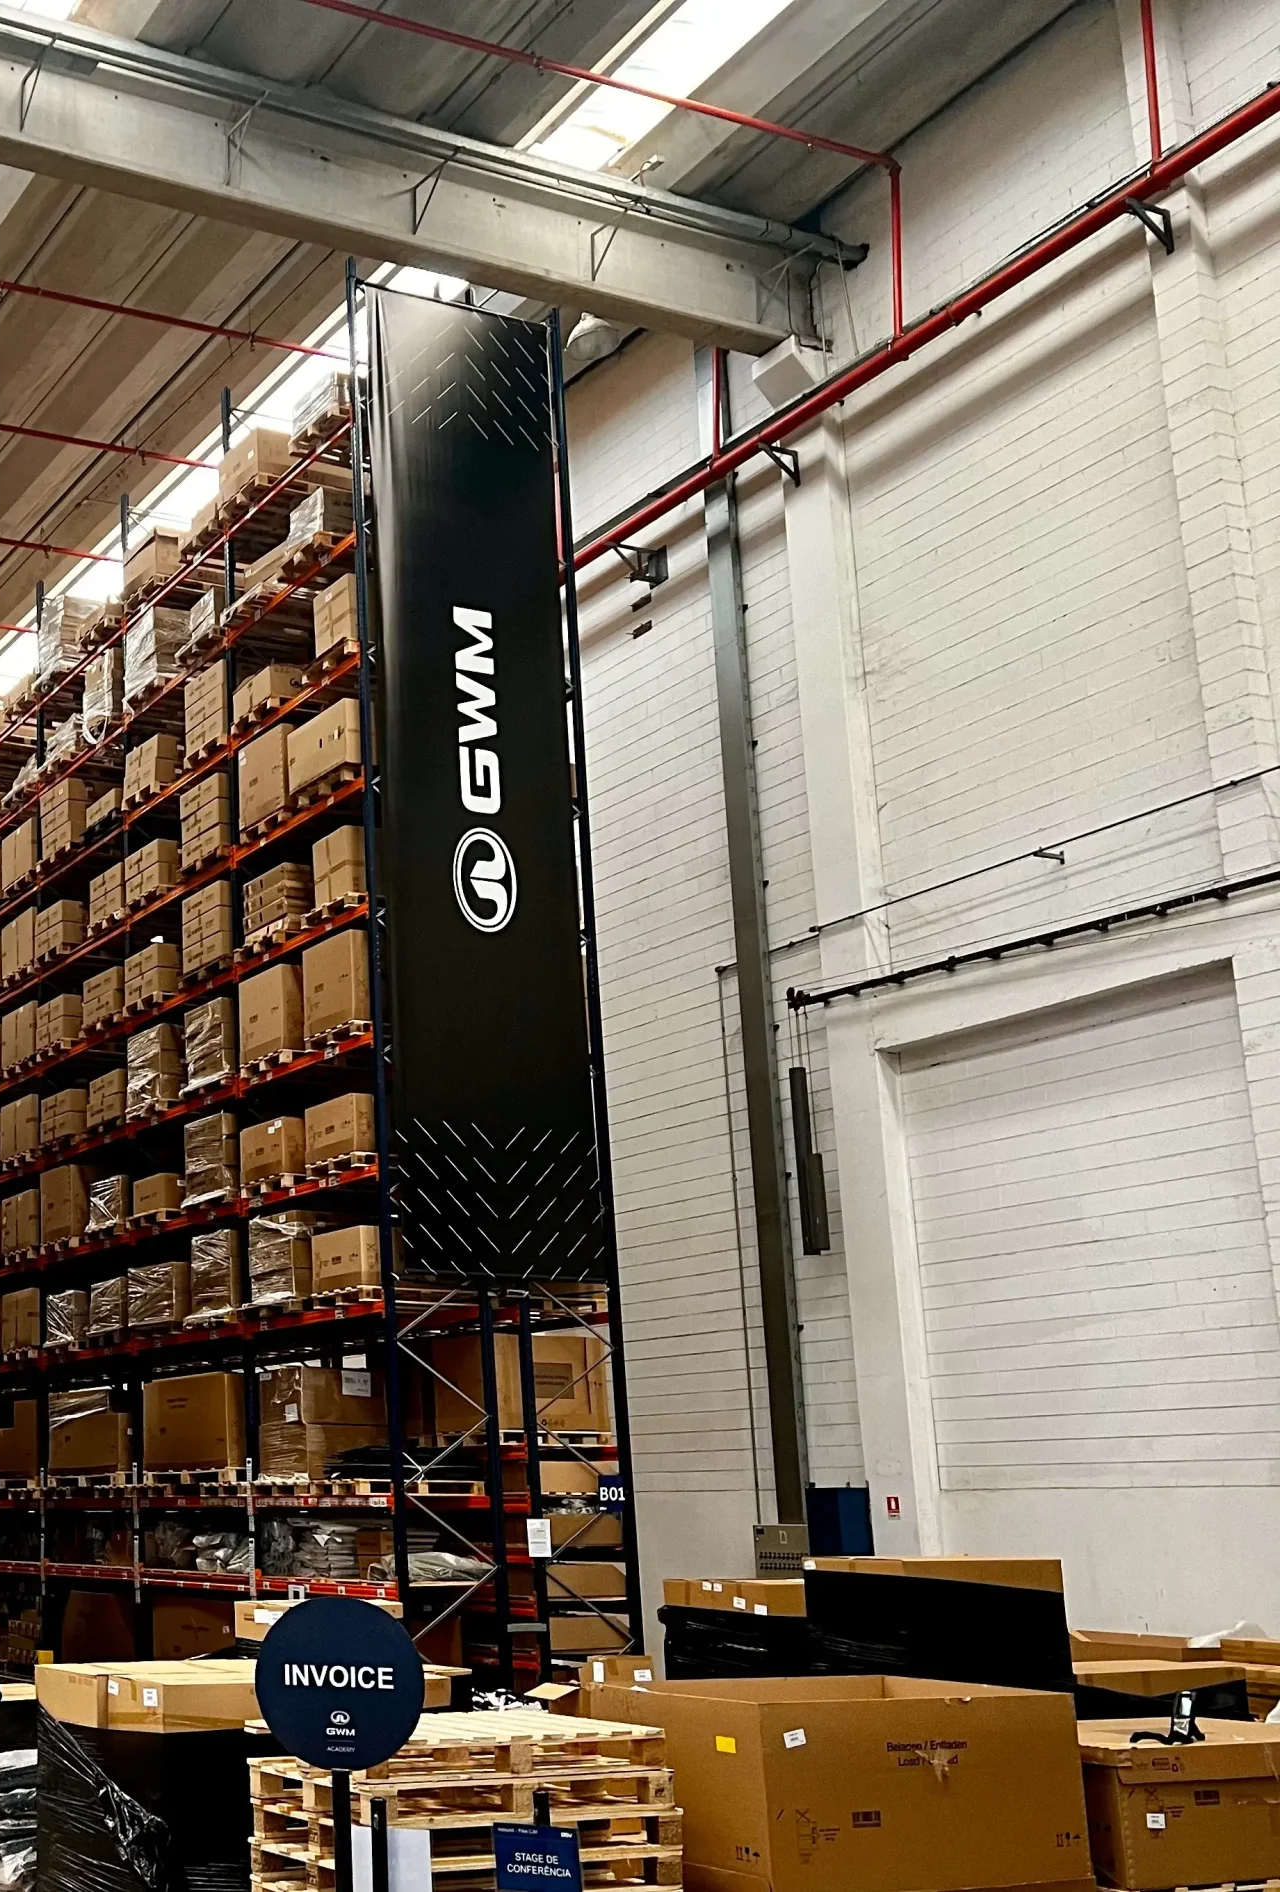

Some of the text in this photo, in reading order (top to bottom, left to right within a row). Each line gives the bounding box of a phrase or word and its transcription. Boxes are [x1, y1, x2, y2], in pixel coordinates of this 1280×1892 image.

[452, 605, 501, 815] GWM
[599, 1486, 626, 1501] B01
[284, 1663, 395, 1690] INVOICE
[326, 1727, 356, 1737] GWM
[514, 1852, 559, 1864] STAGE DE
[506, 1863, 572, 1878] CONFERÊNCIA
